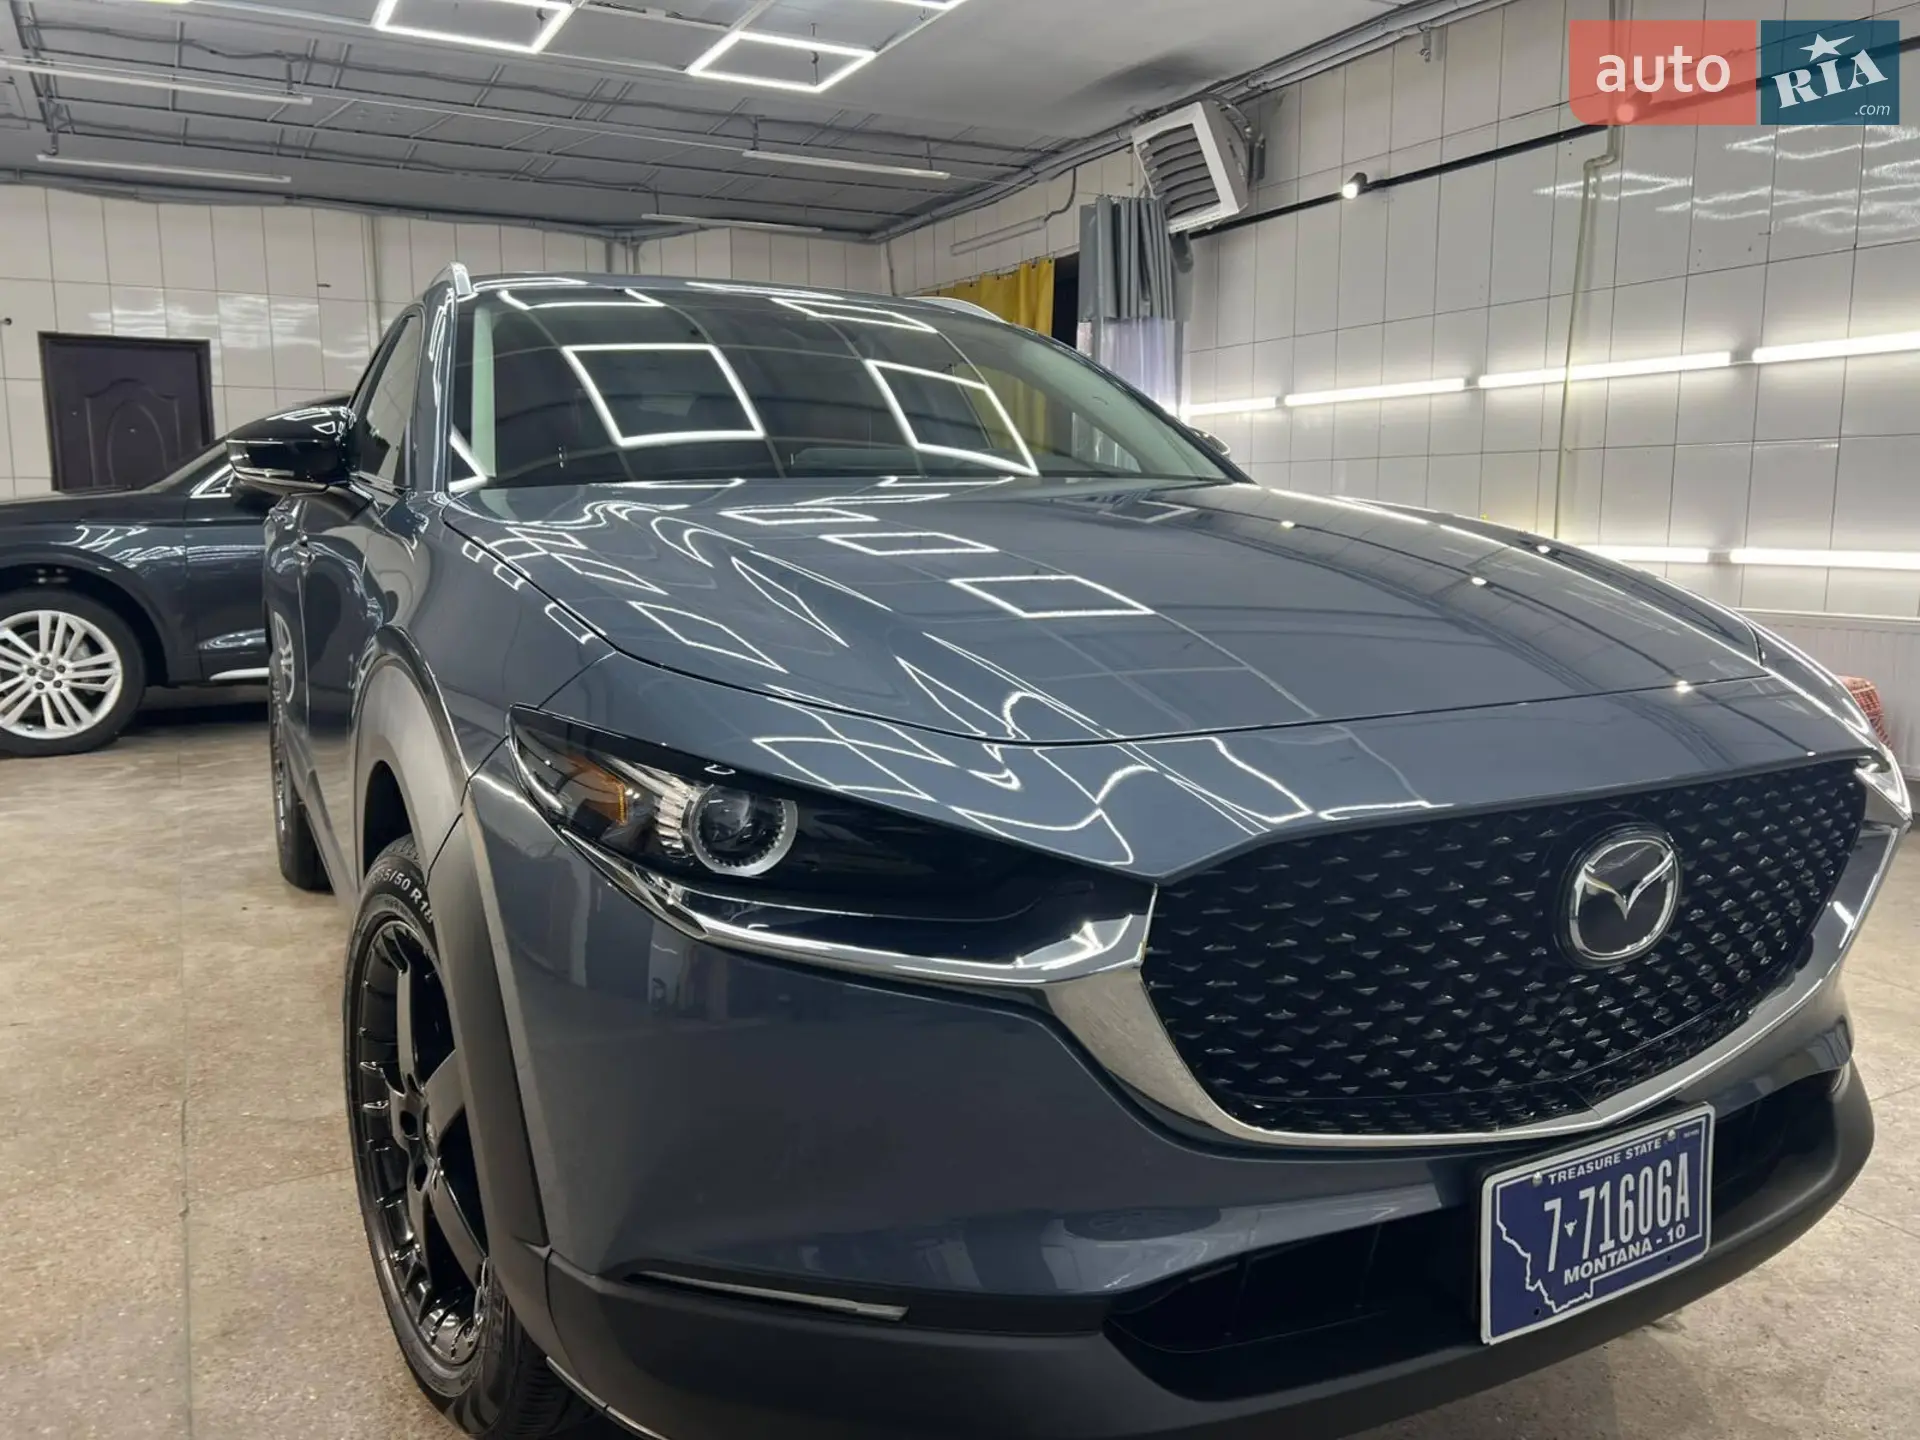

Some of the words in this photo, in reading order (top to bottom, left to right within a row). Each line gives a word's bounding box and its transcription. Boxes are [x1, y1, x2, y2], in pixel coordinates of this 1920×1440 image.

[1549, 1150, 1621, 1186] TREASURE
[1625, 1138, 1662, 1160] STATE
[1563, 1241, 1653, 1286] MONTANA
